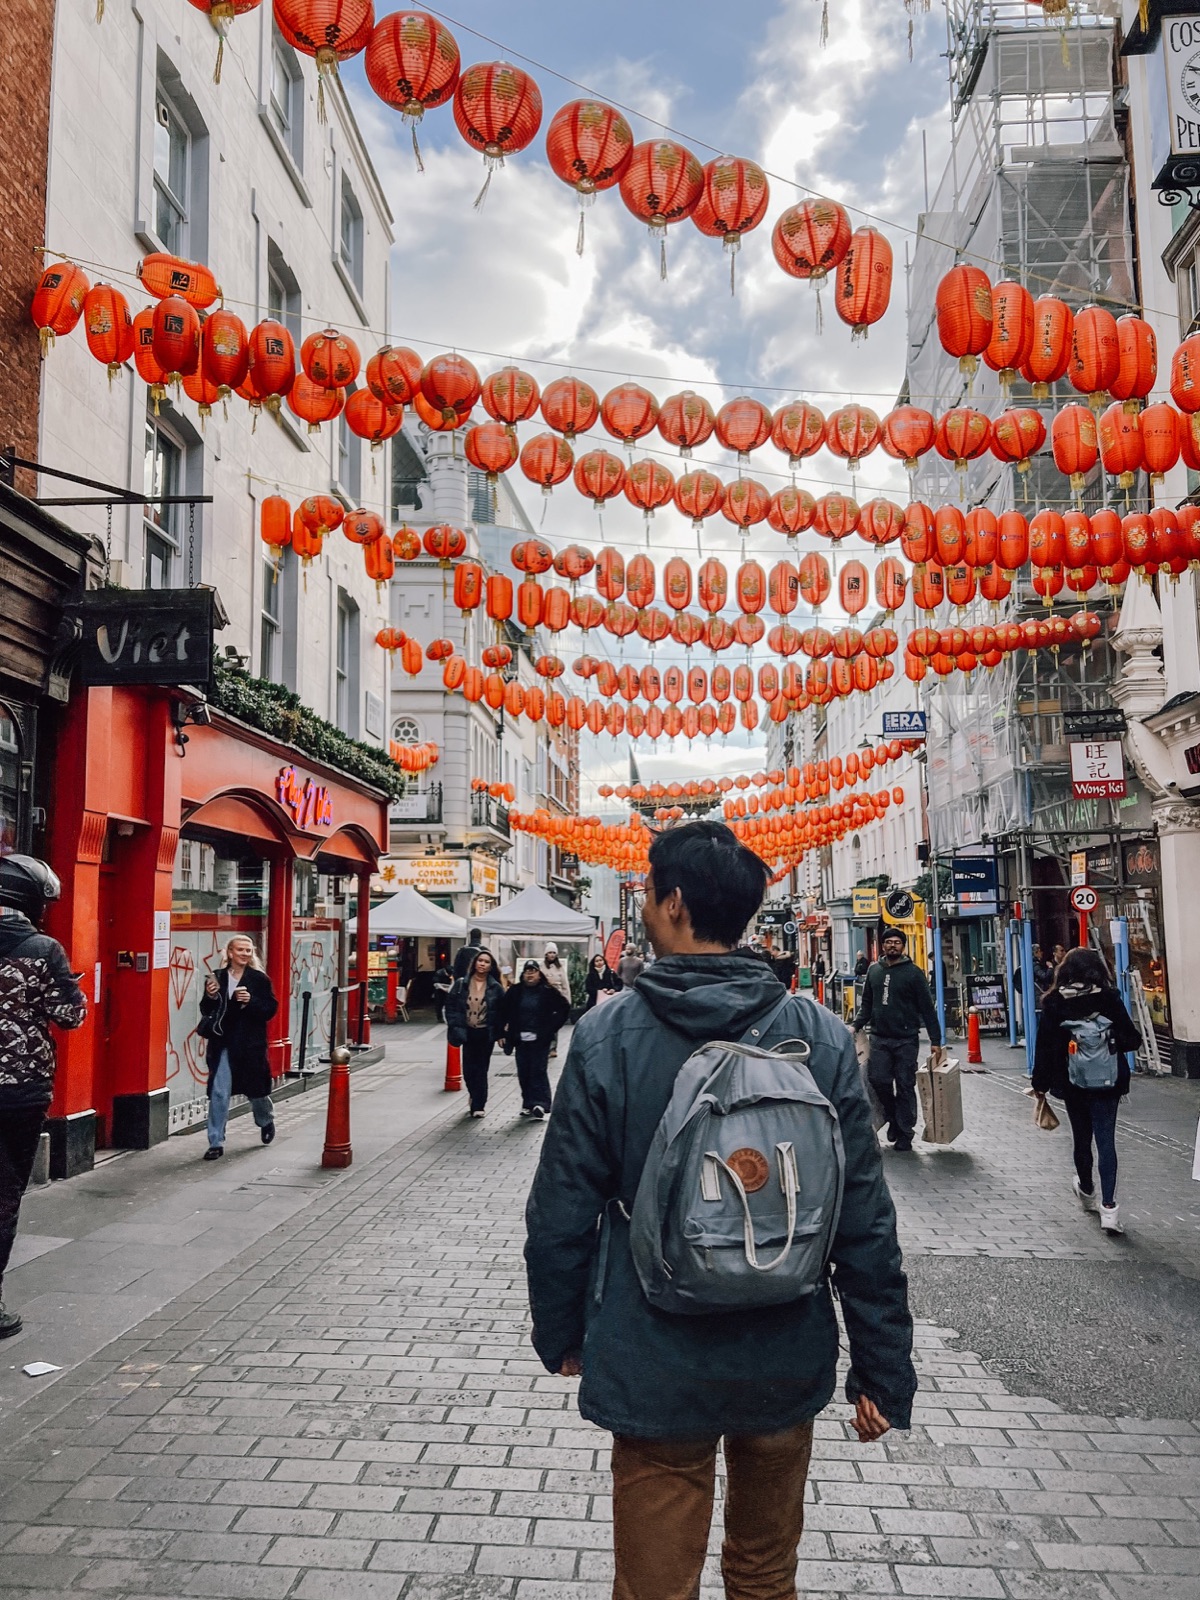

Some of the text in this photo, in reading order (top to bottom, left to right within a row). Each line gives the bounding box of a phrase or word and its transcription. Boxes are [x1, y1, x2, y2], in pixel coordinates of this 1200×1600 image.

[1176, 114, 1200, 148] PE
[97, 620, 190, 663] Viet
[891, 713, 924, 727] ERA
[1075, 782, 1124, 796] Wong Kei
[418, 870, 454, 878] CORNER
[398, 878, 458, 886] RESTAURANT
[1076, 893, 1095, 905] 20
[977, 988, 997, 997] HAPPY
[980, 996, 998, 1004] HOUR
